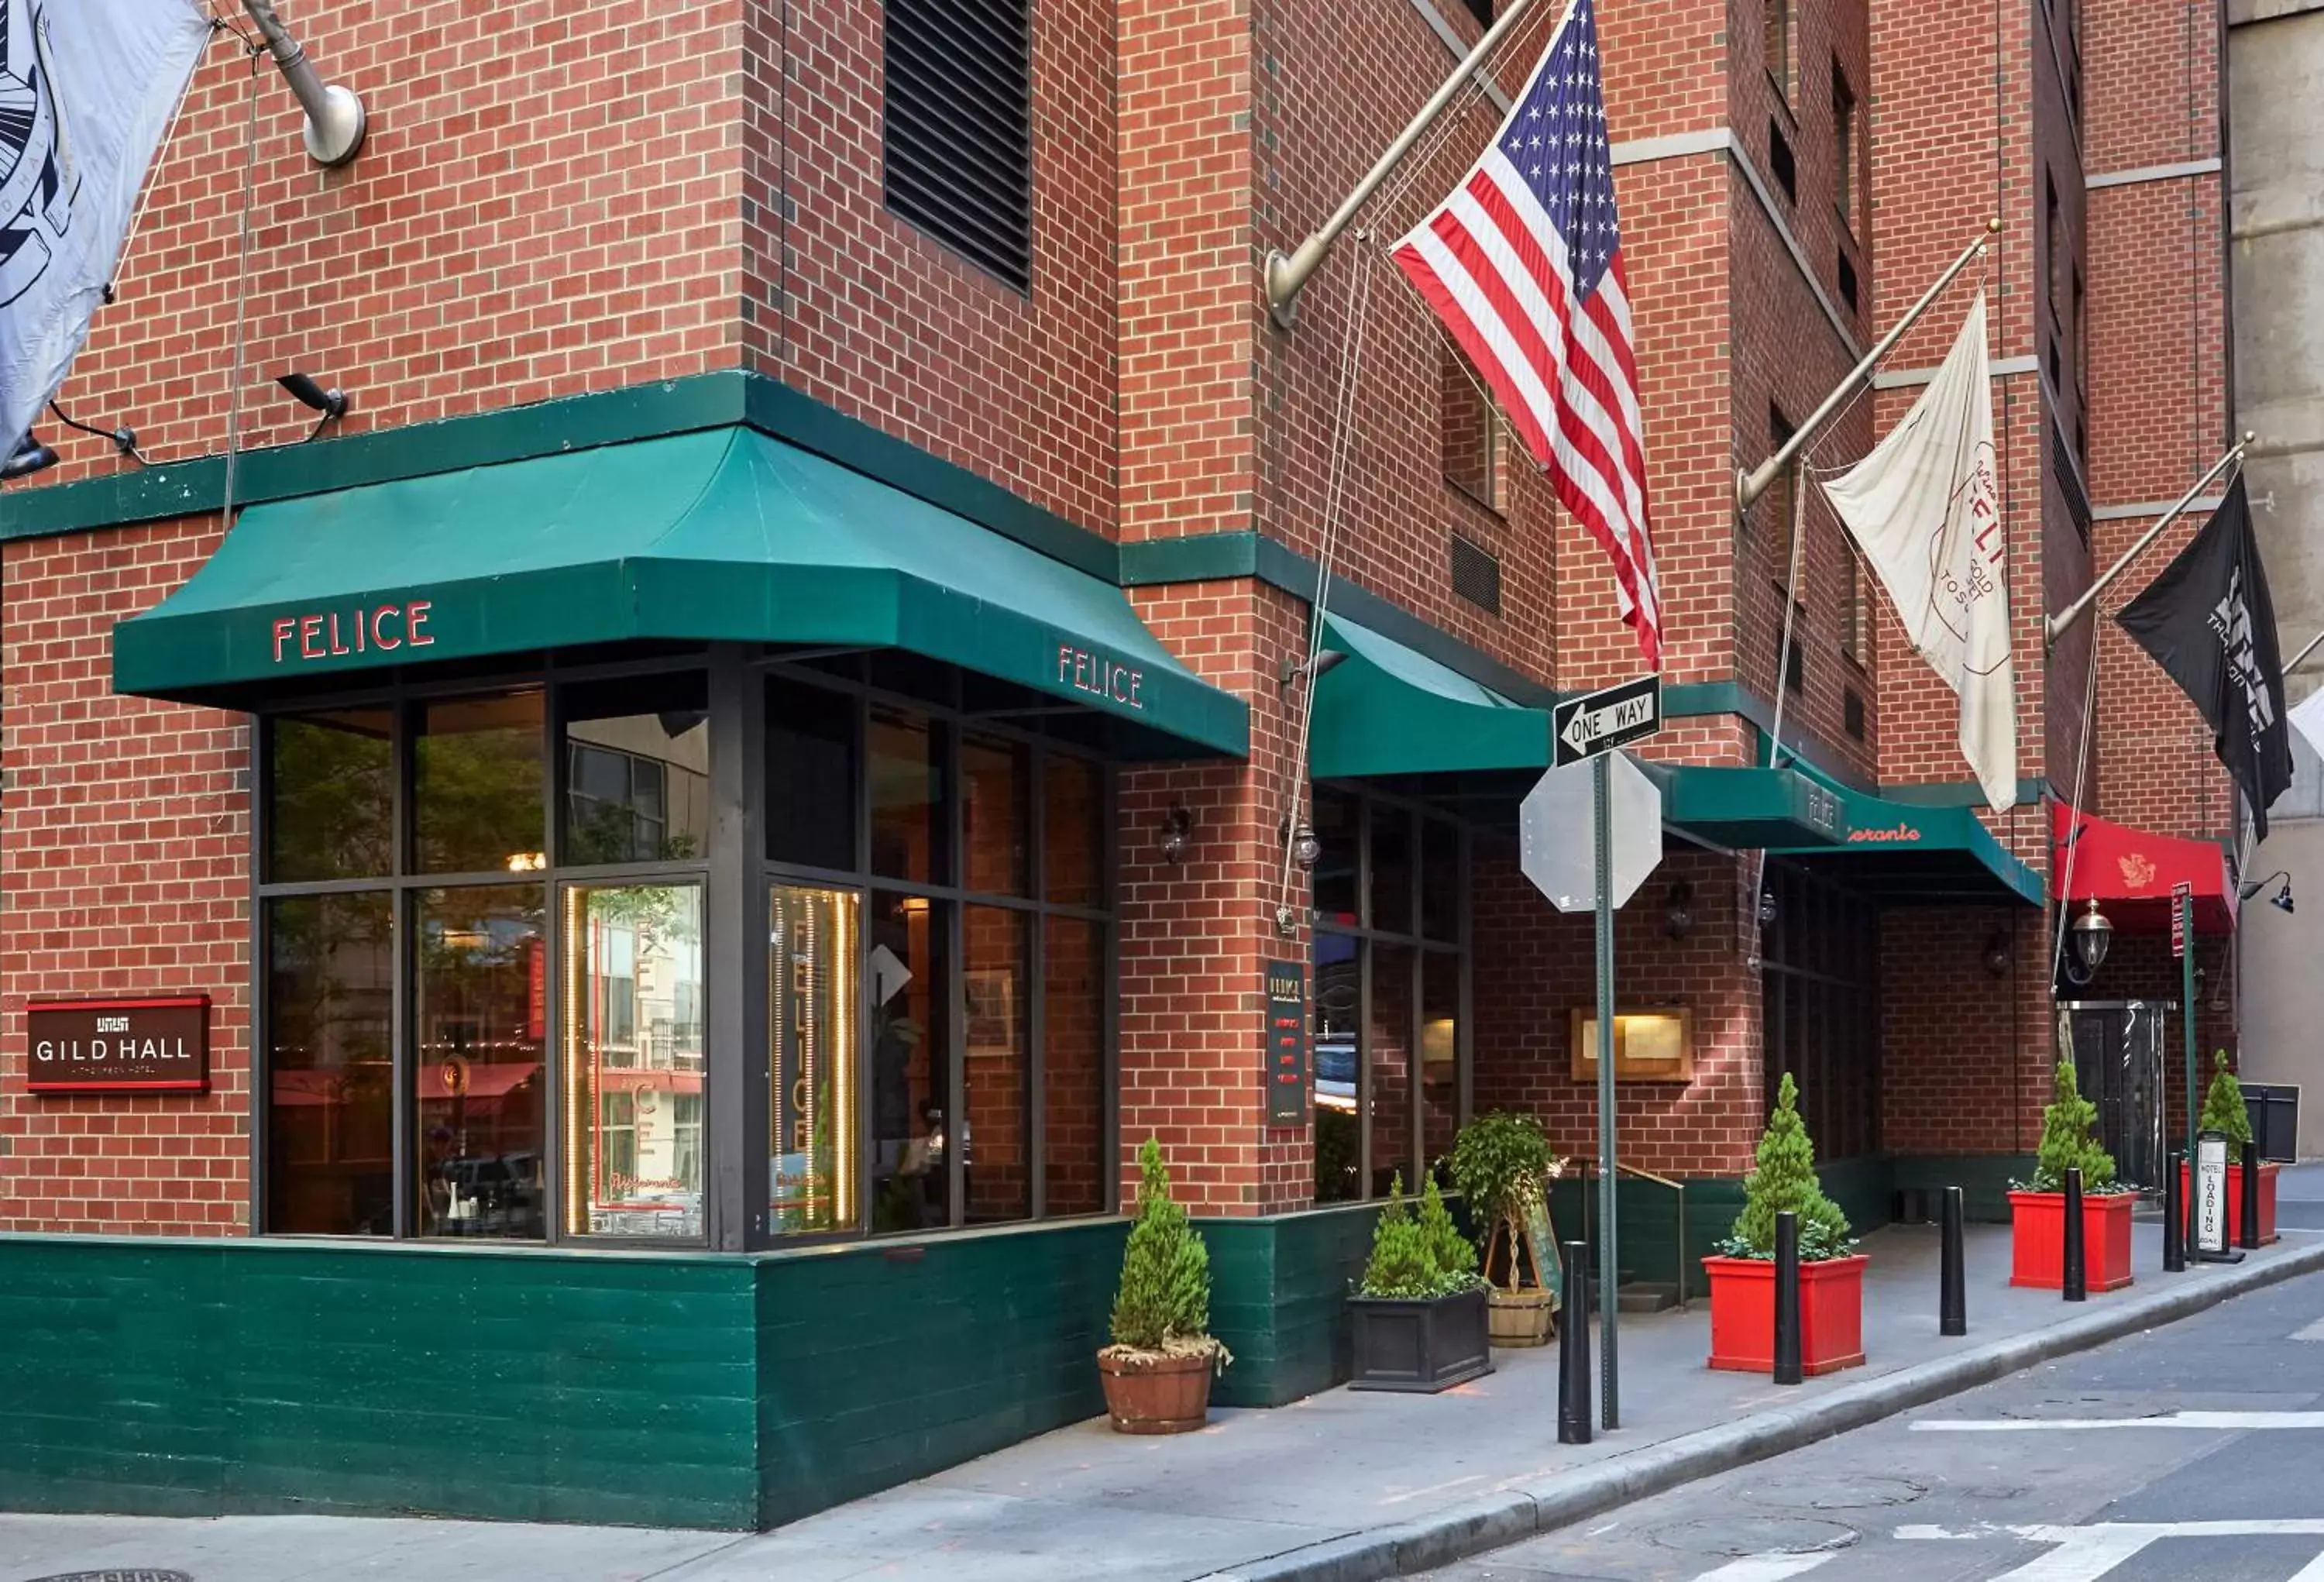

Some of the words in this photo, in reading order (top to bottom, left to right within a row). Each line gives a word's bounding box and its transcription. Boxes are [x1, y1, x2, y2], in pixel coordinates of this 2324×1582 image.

[273, 600, 435, 662] FELICE
[1059, 645, 1143, 709] FELICE
[1572, 713, 1602, 742] ONE
[1615, 698, 1646, 728] WAY
[36, 1040, 108, 1061] GILD
[119, 1037, 191, 1059] HALL
[2205, 1176, 2215, 1233] LOADING
